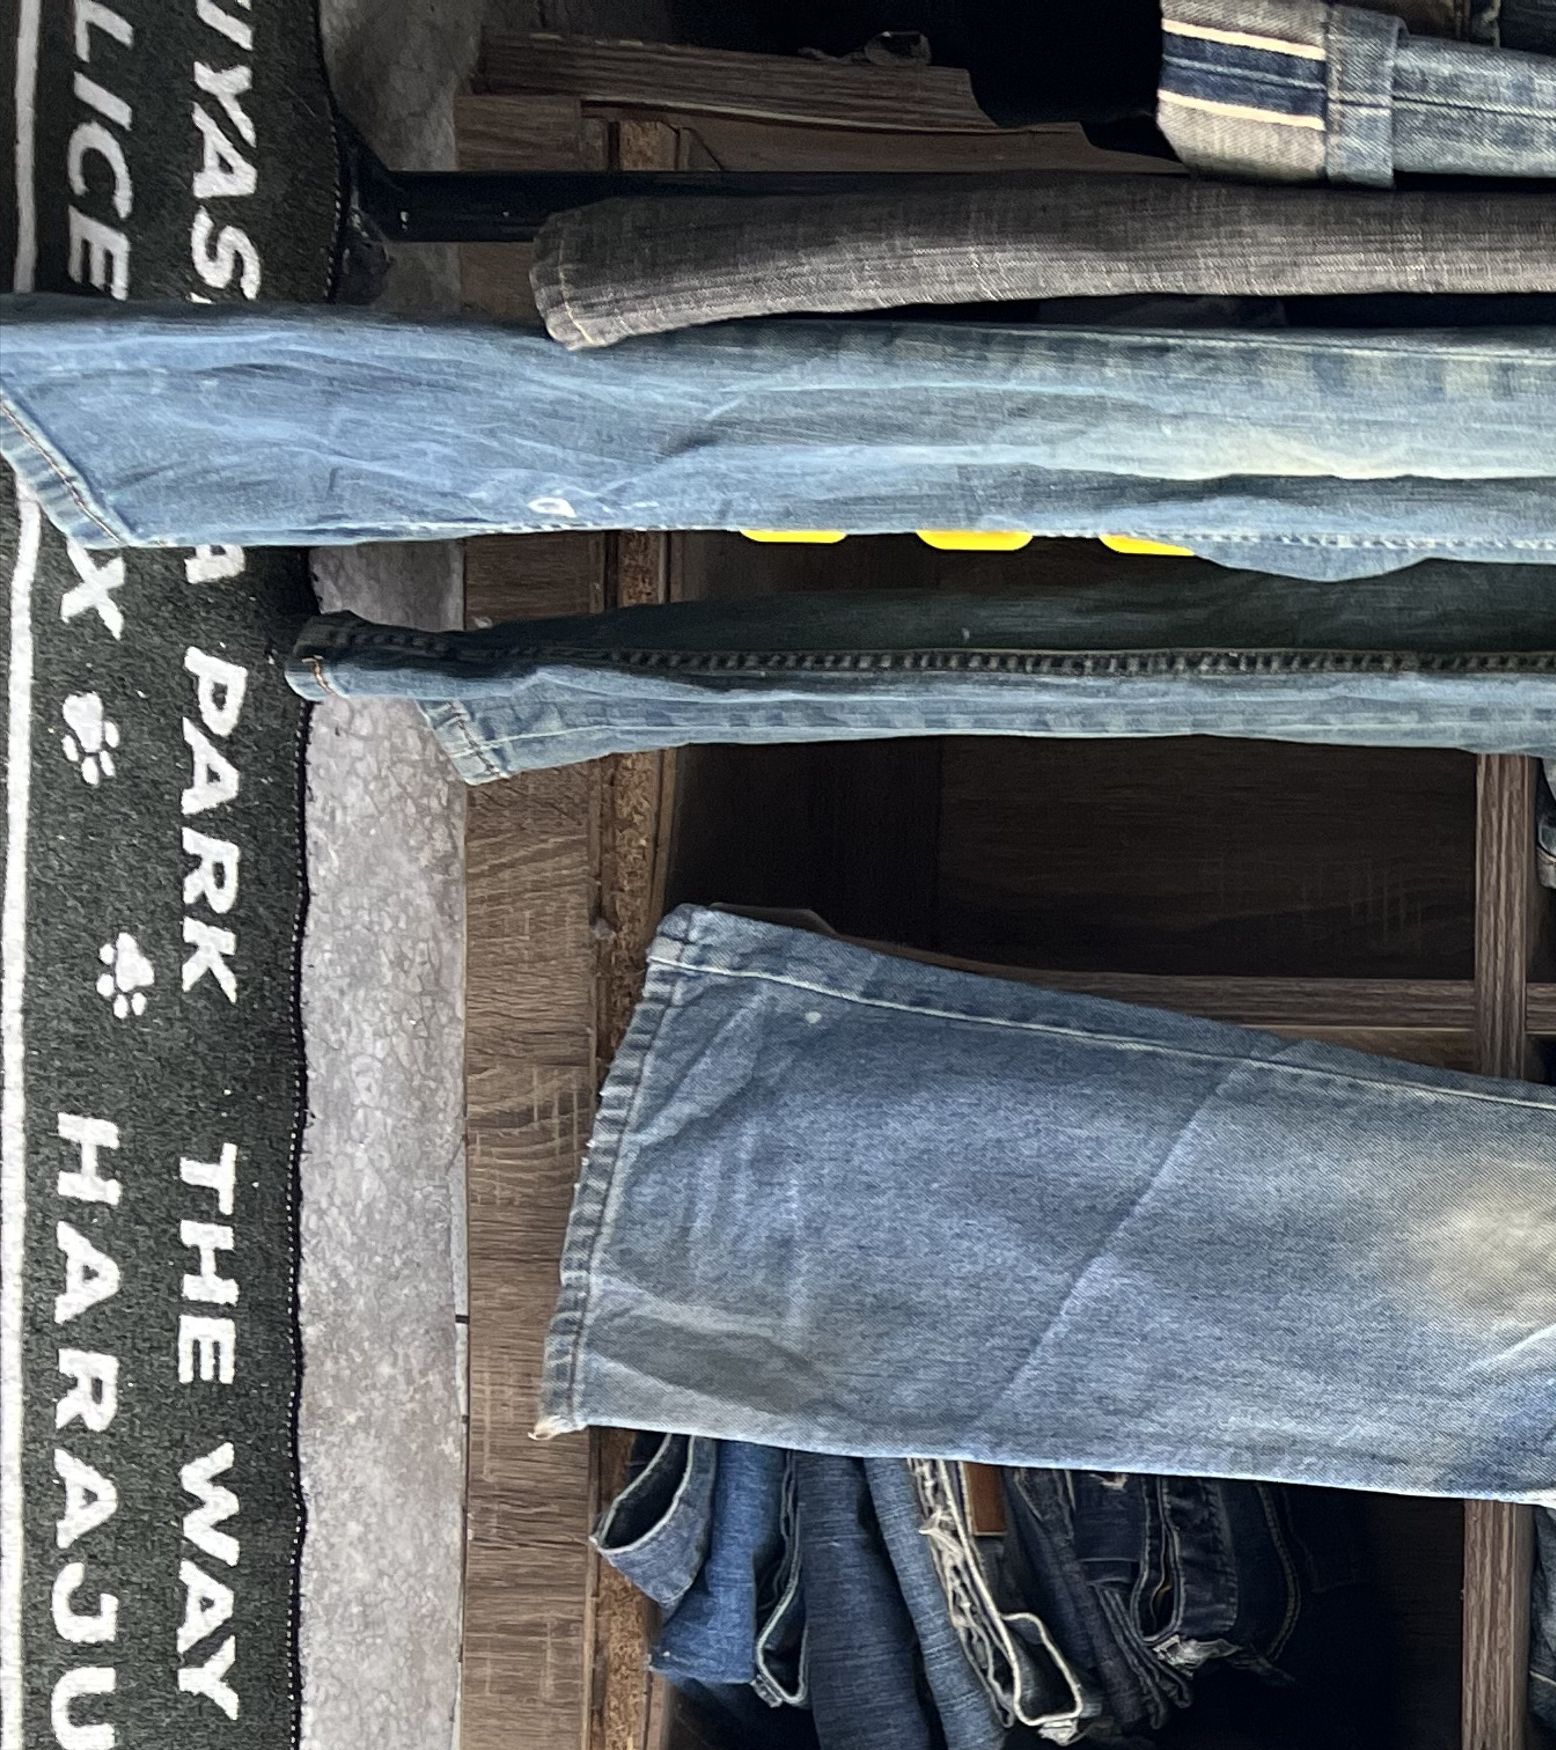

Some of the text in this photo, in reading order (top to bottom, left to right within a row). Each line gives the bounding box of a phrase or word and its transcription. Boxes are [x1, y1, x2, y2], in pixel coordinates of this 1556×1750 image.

[179, 646, 249, 1004] PARK
[178, 1143, 238, 1385] THE
[176, 1442, 239, 1720] WAY
